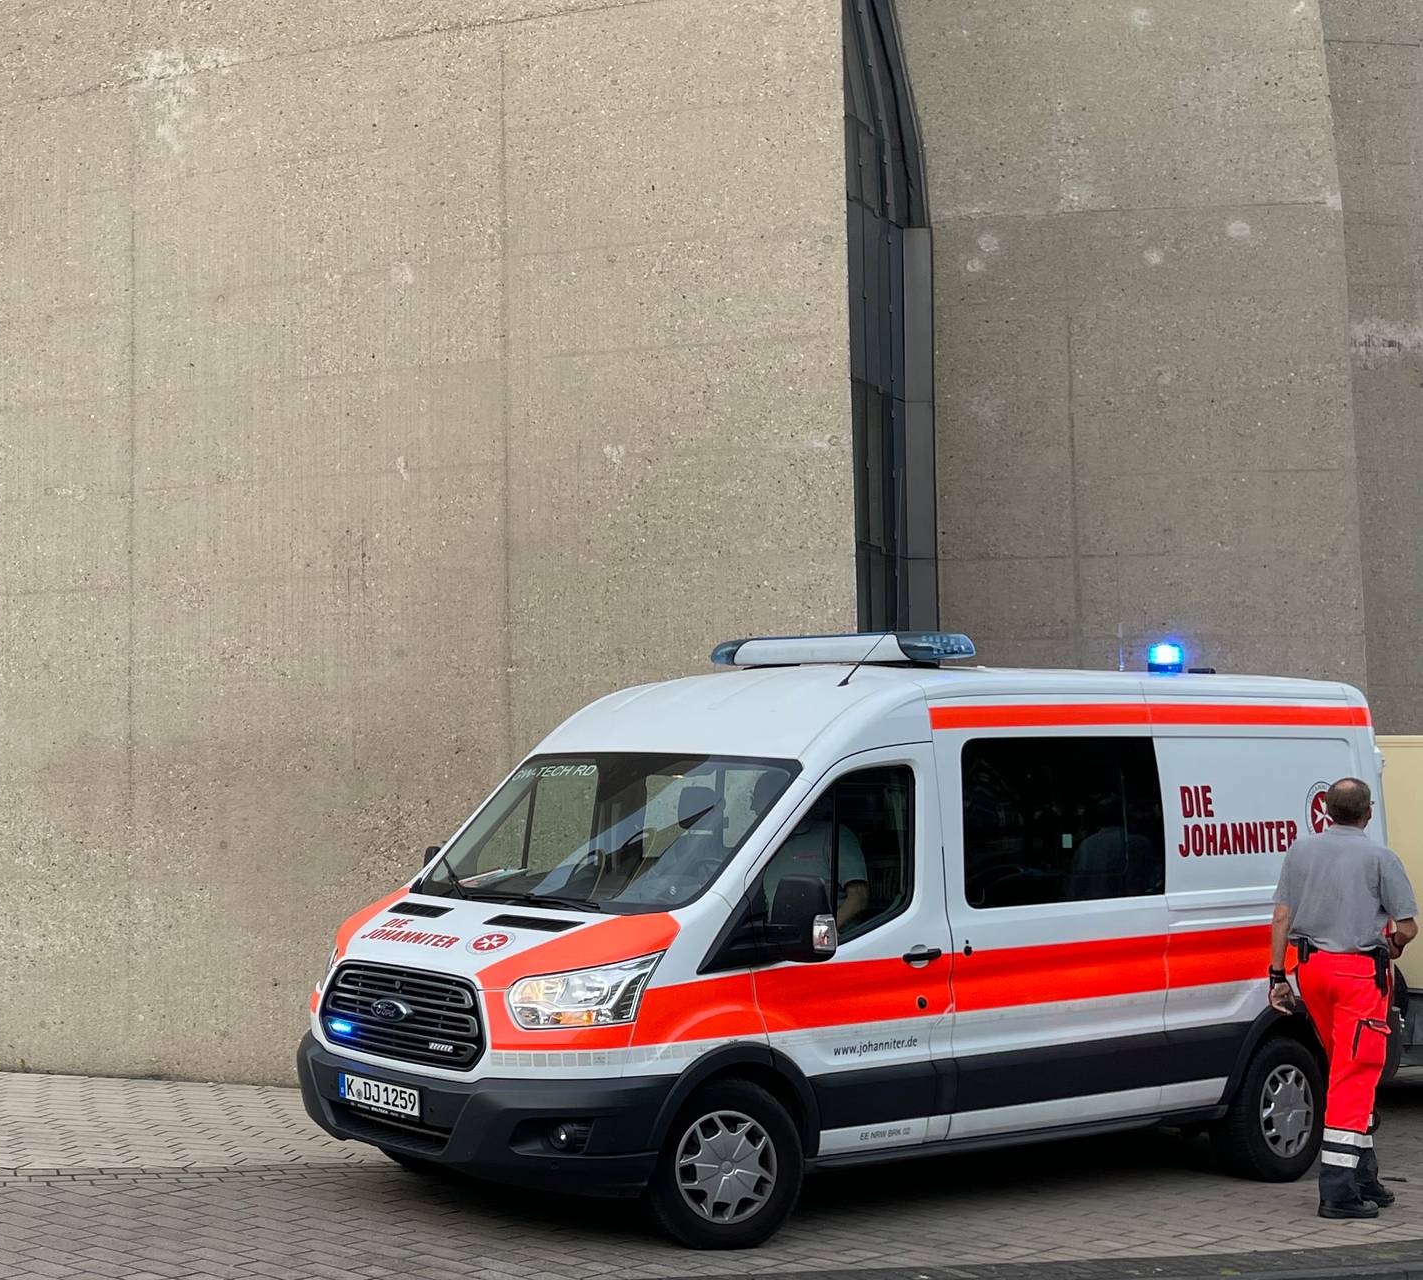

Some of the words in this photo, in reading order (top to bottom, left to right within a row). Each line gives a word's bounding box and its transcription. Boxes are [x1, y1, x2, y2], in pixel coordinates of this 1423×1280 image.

[574, 764, 597, 777] RD
[1179, 785, 1215, 818] DIE
[1178, 820, 1298, 858] JOHANNITER
[380, 917, 414, 929] DIE
[360, 928, 461, 949] JOHANNITER
[834, 1036, 918, 1056] www.johanniter.de
[346, 1077, 355, 1098] K
[382, 1086, 417, 1112] 1259
